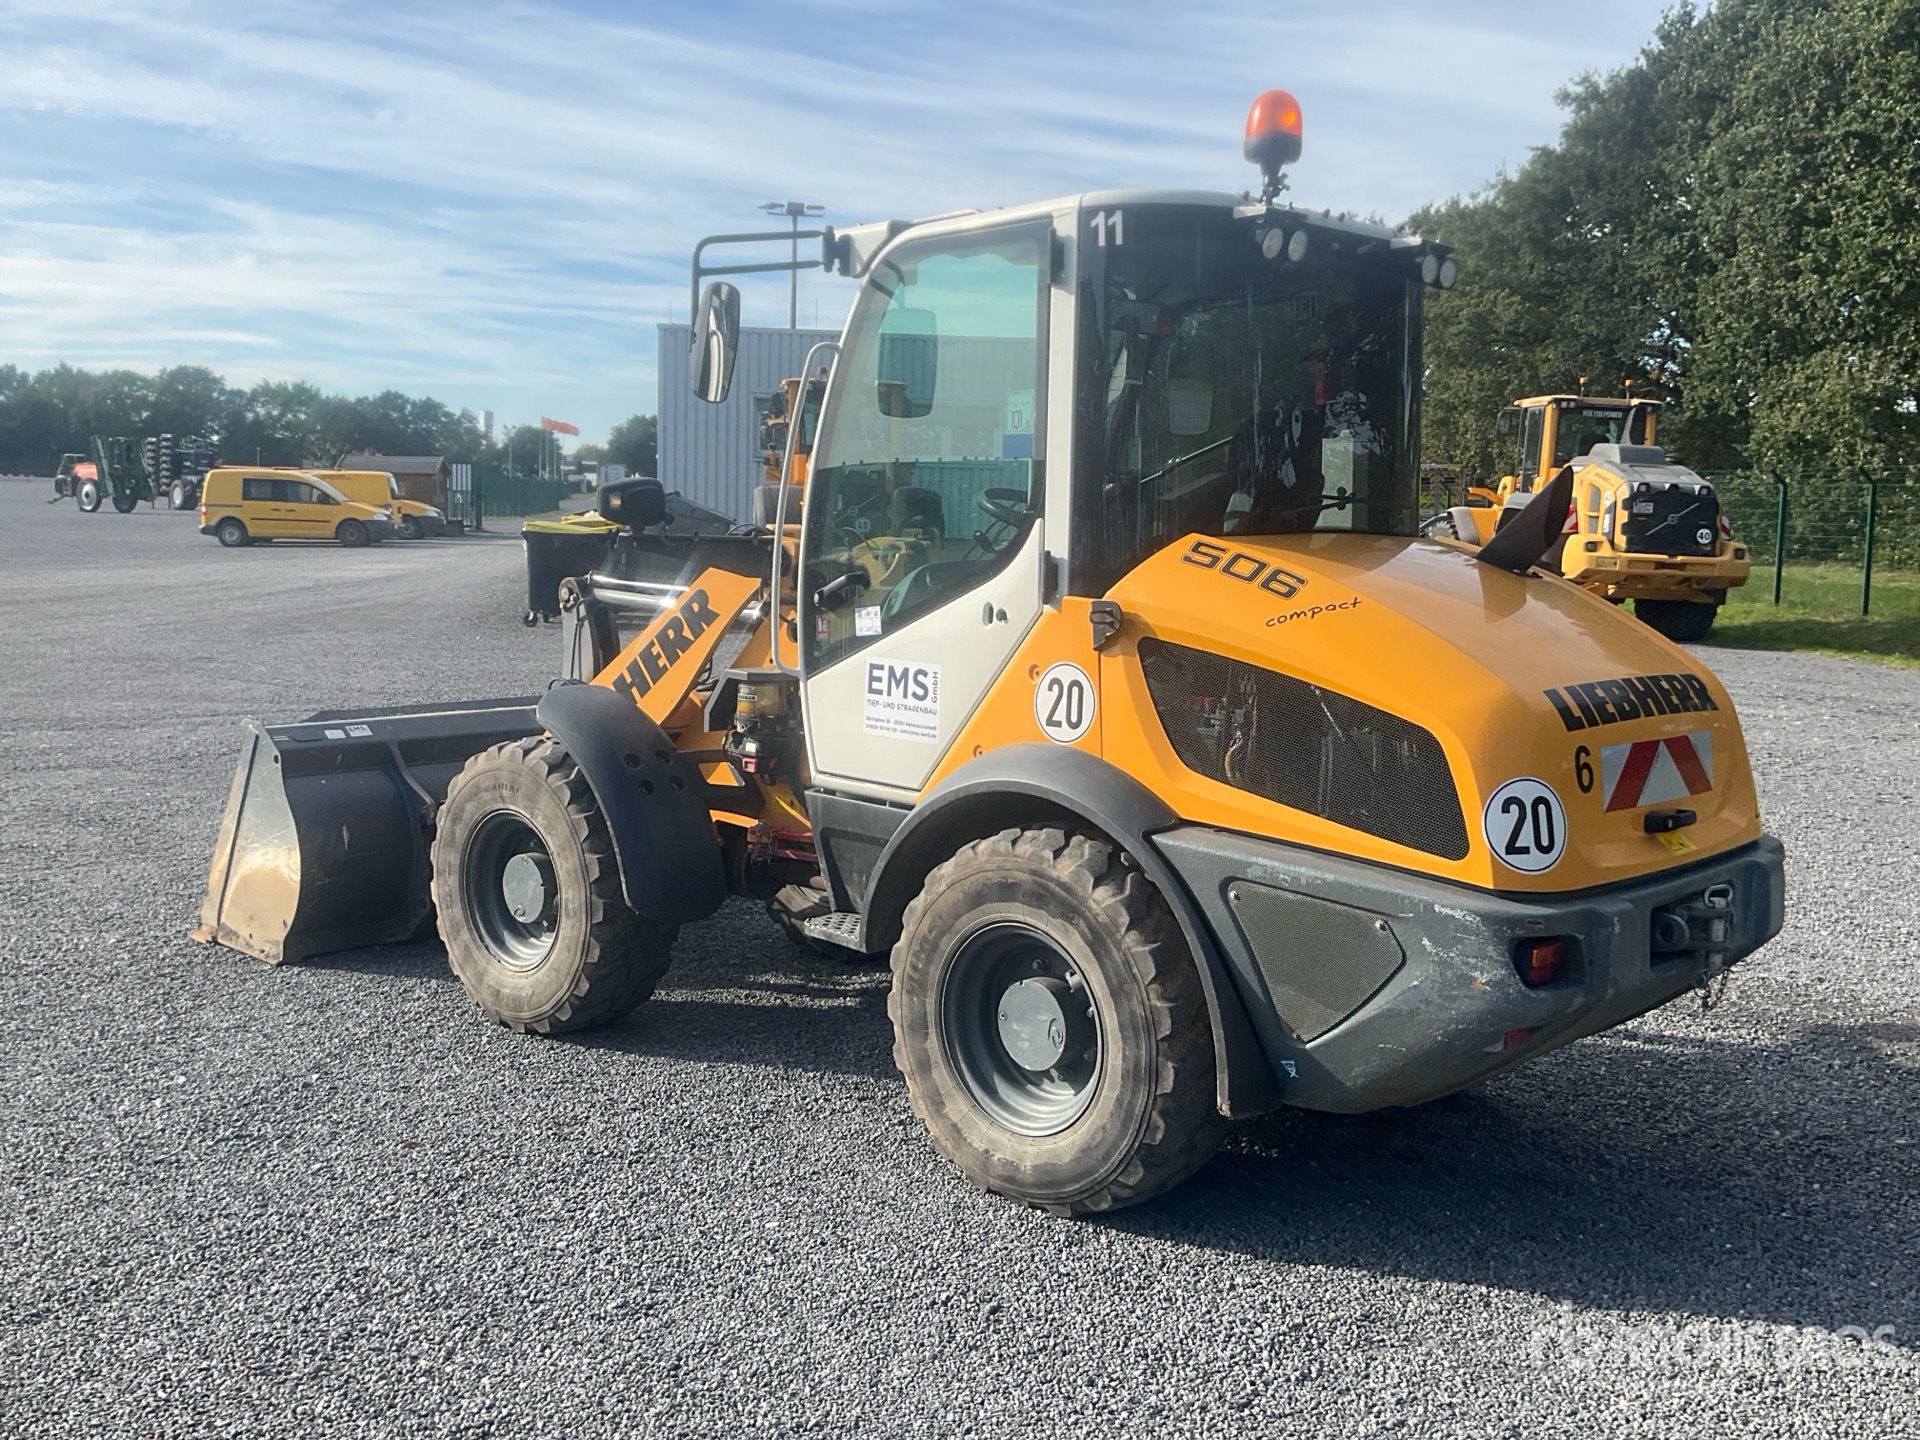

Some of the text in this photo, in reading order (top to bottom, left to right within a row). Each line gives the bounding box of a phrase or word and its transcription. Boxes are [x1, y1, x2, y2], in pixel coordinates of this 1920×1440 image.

[1090, 209, 1123, 247] 11
[1697, 531, 1711, 541] 40
[1180, 539, 1309, 601] 506
[1264, 596, 1362, 628] compact
[867, 662, 930, 702] EMS
[930, 671, 939, 704] GmbH
[882, 701, 896, 710] UND
[1045, 676, 1084, 730] 20
[1542, 673, 1720, 732] LIEBHERR
[1573, 744, 1594, 794] 6
[1500, 795, 1555, 856] 20
